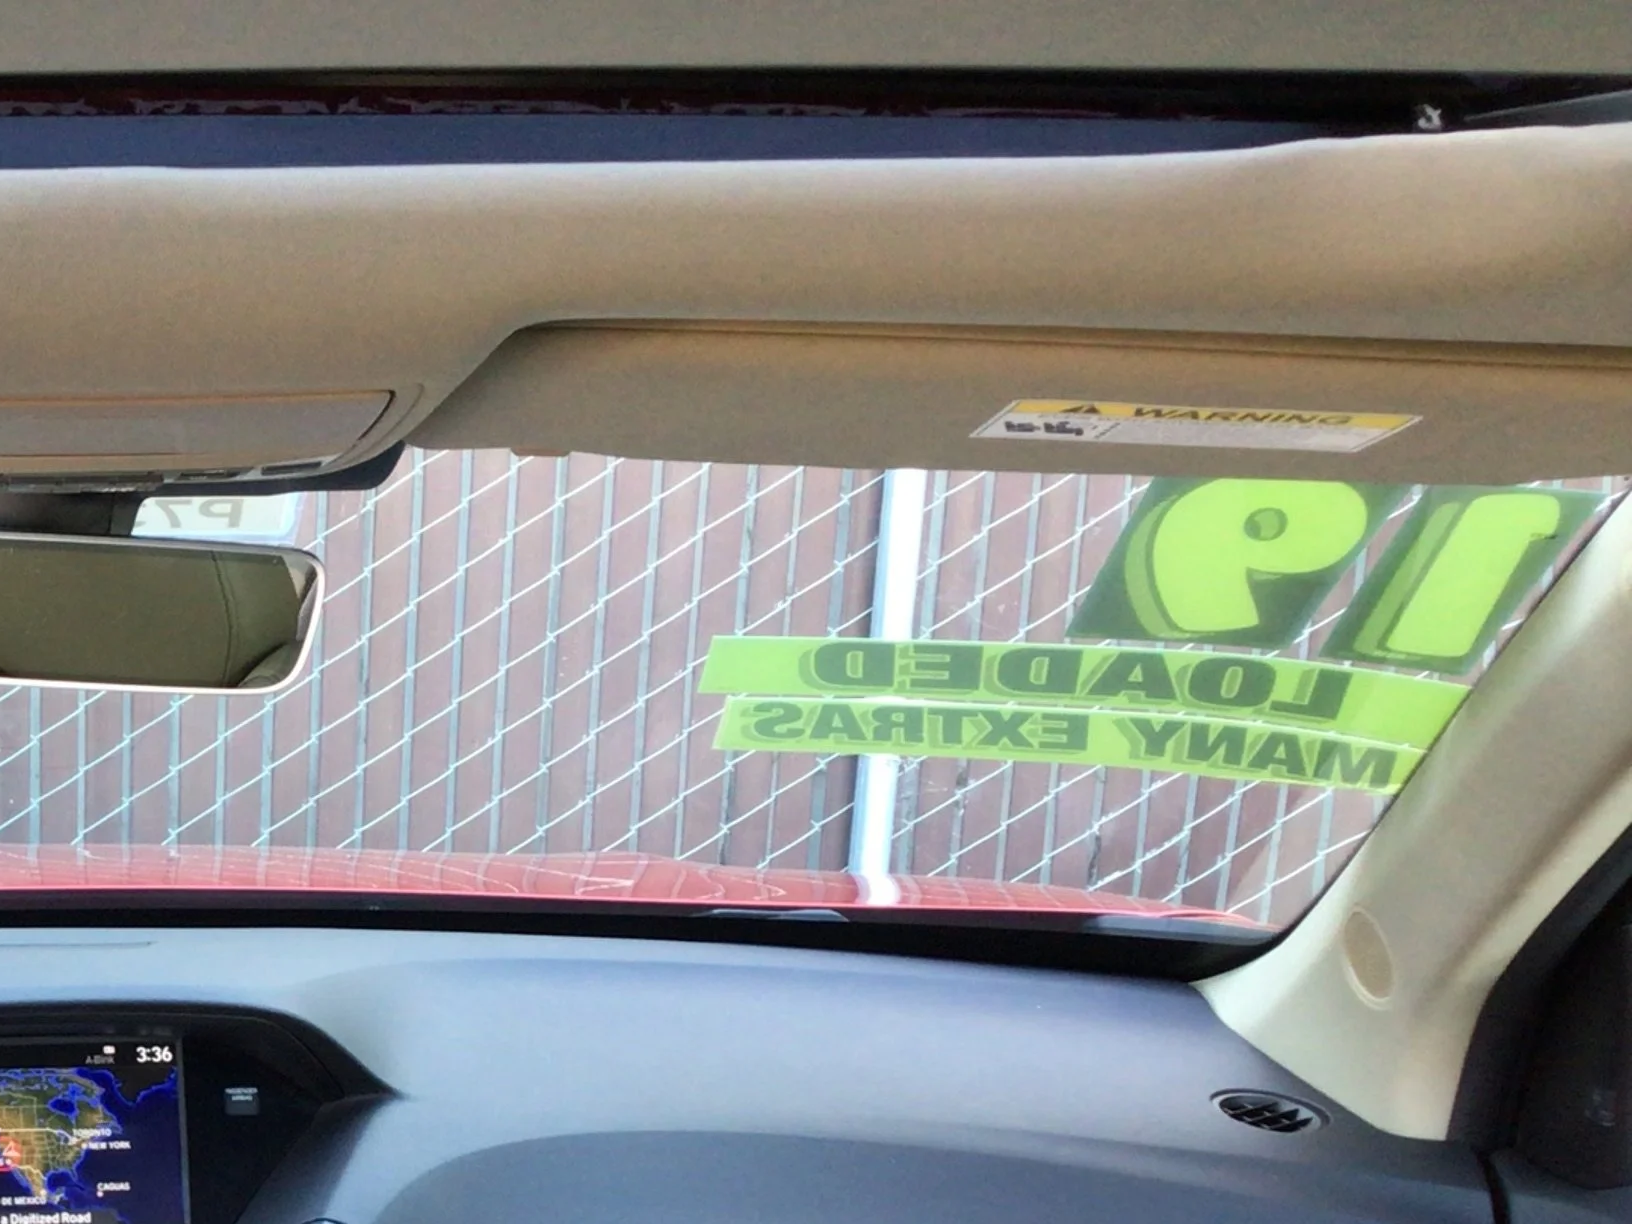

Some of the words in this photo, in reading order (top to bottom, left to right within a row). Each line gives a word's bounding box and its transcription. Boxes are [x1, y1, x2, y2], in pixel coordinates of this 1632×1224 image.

[1134, 407, 1354, 426] WARNING
[136, 1046, 173, 1063] 3:36
[73, 1128, 112, 1137] TORONTO
[88, 1142, 107, 1150] NEW
[109, 1141, 131, 1149] YORK
[97, 1183, 130, 1191] CAGUAS
[2, 1198, 13, 1206] DE
[62, 1212, 91, 1224] Road
